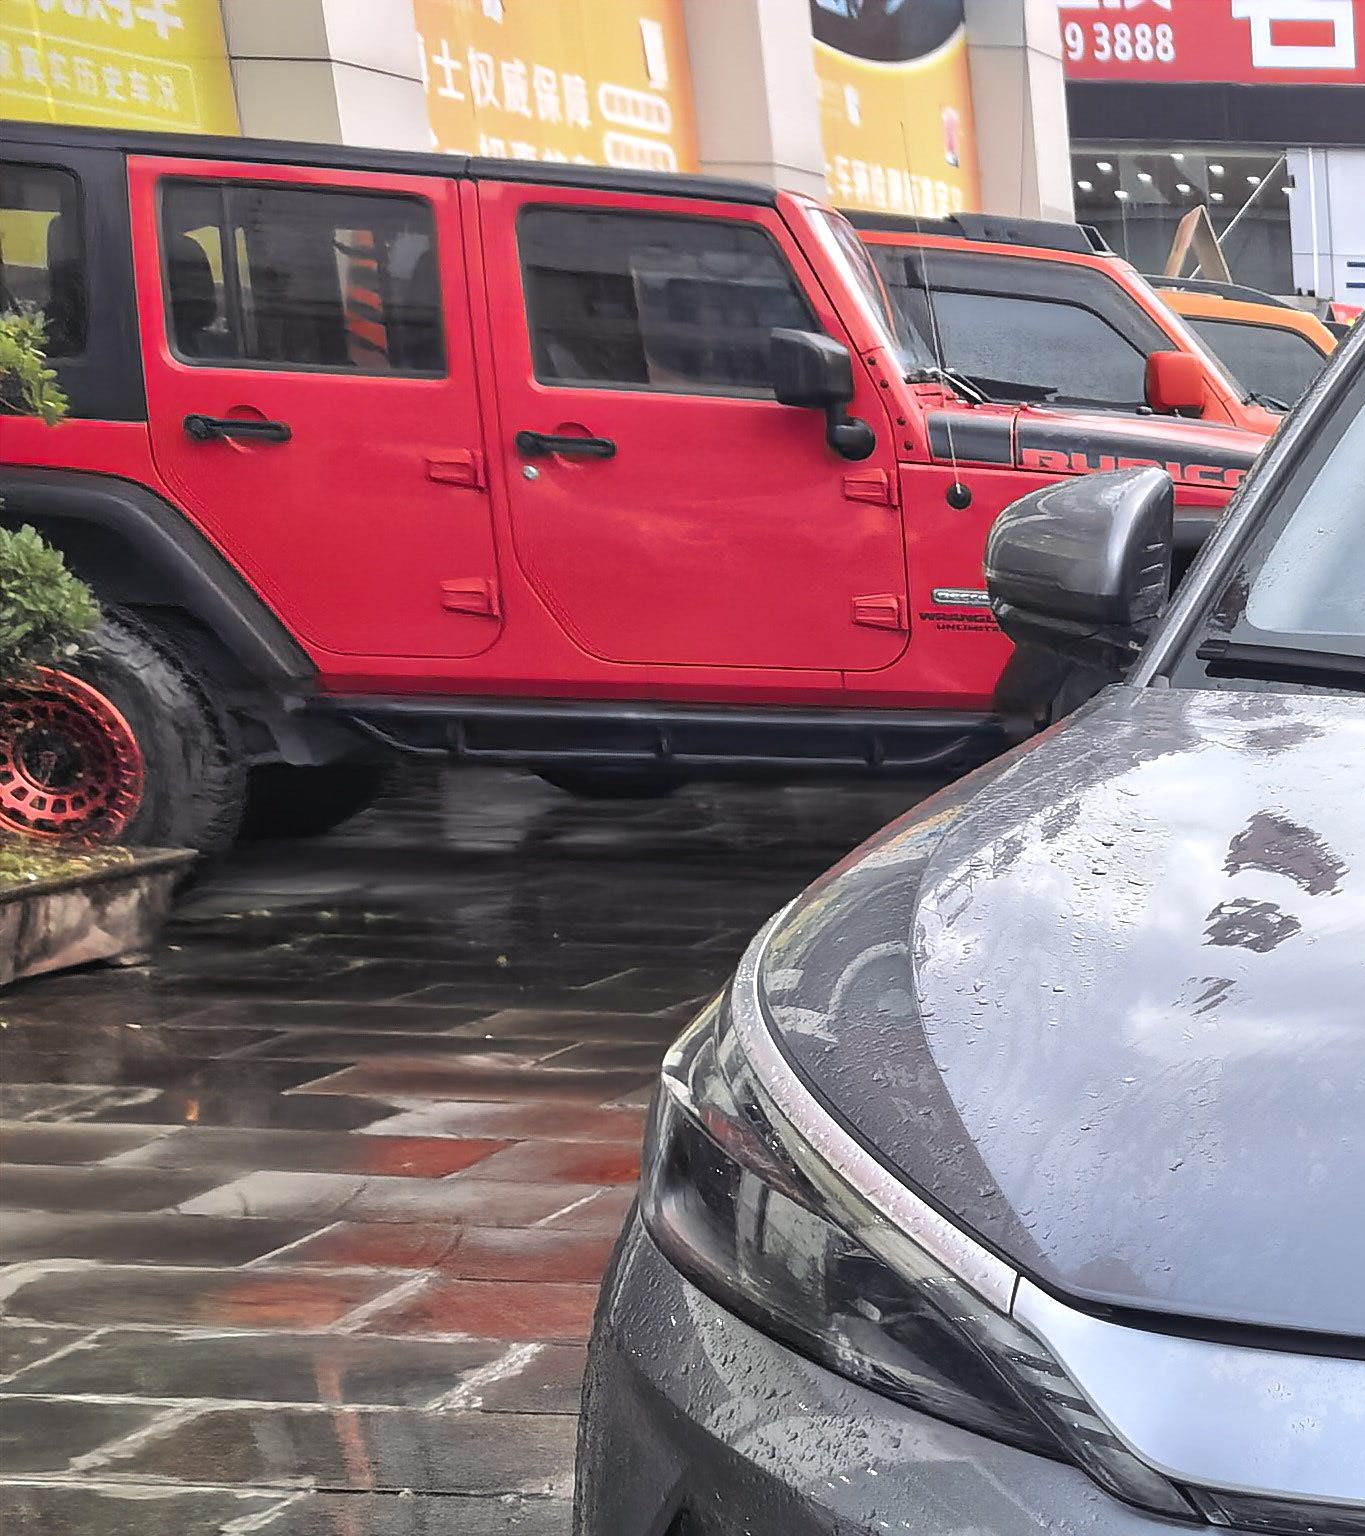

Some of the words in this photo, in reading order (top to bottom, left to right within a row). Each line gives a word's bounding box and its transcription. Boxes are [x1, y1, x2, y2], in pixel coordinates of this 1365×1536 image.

[1092, 21, 1176, 62] 3888
[416, 31, 593, 130] 士权威保障
